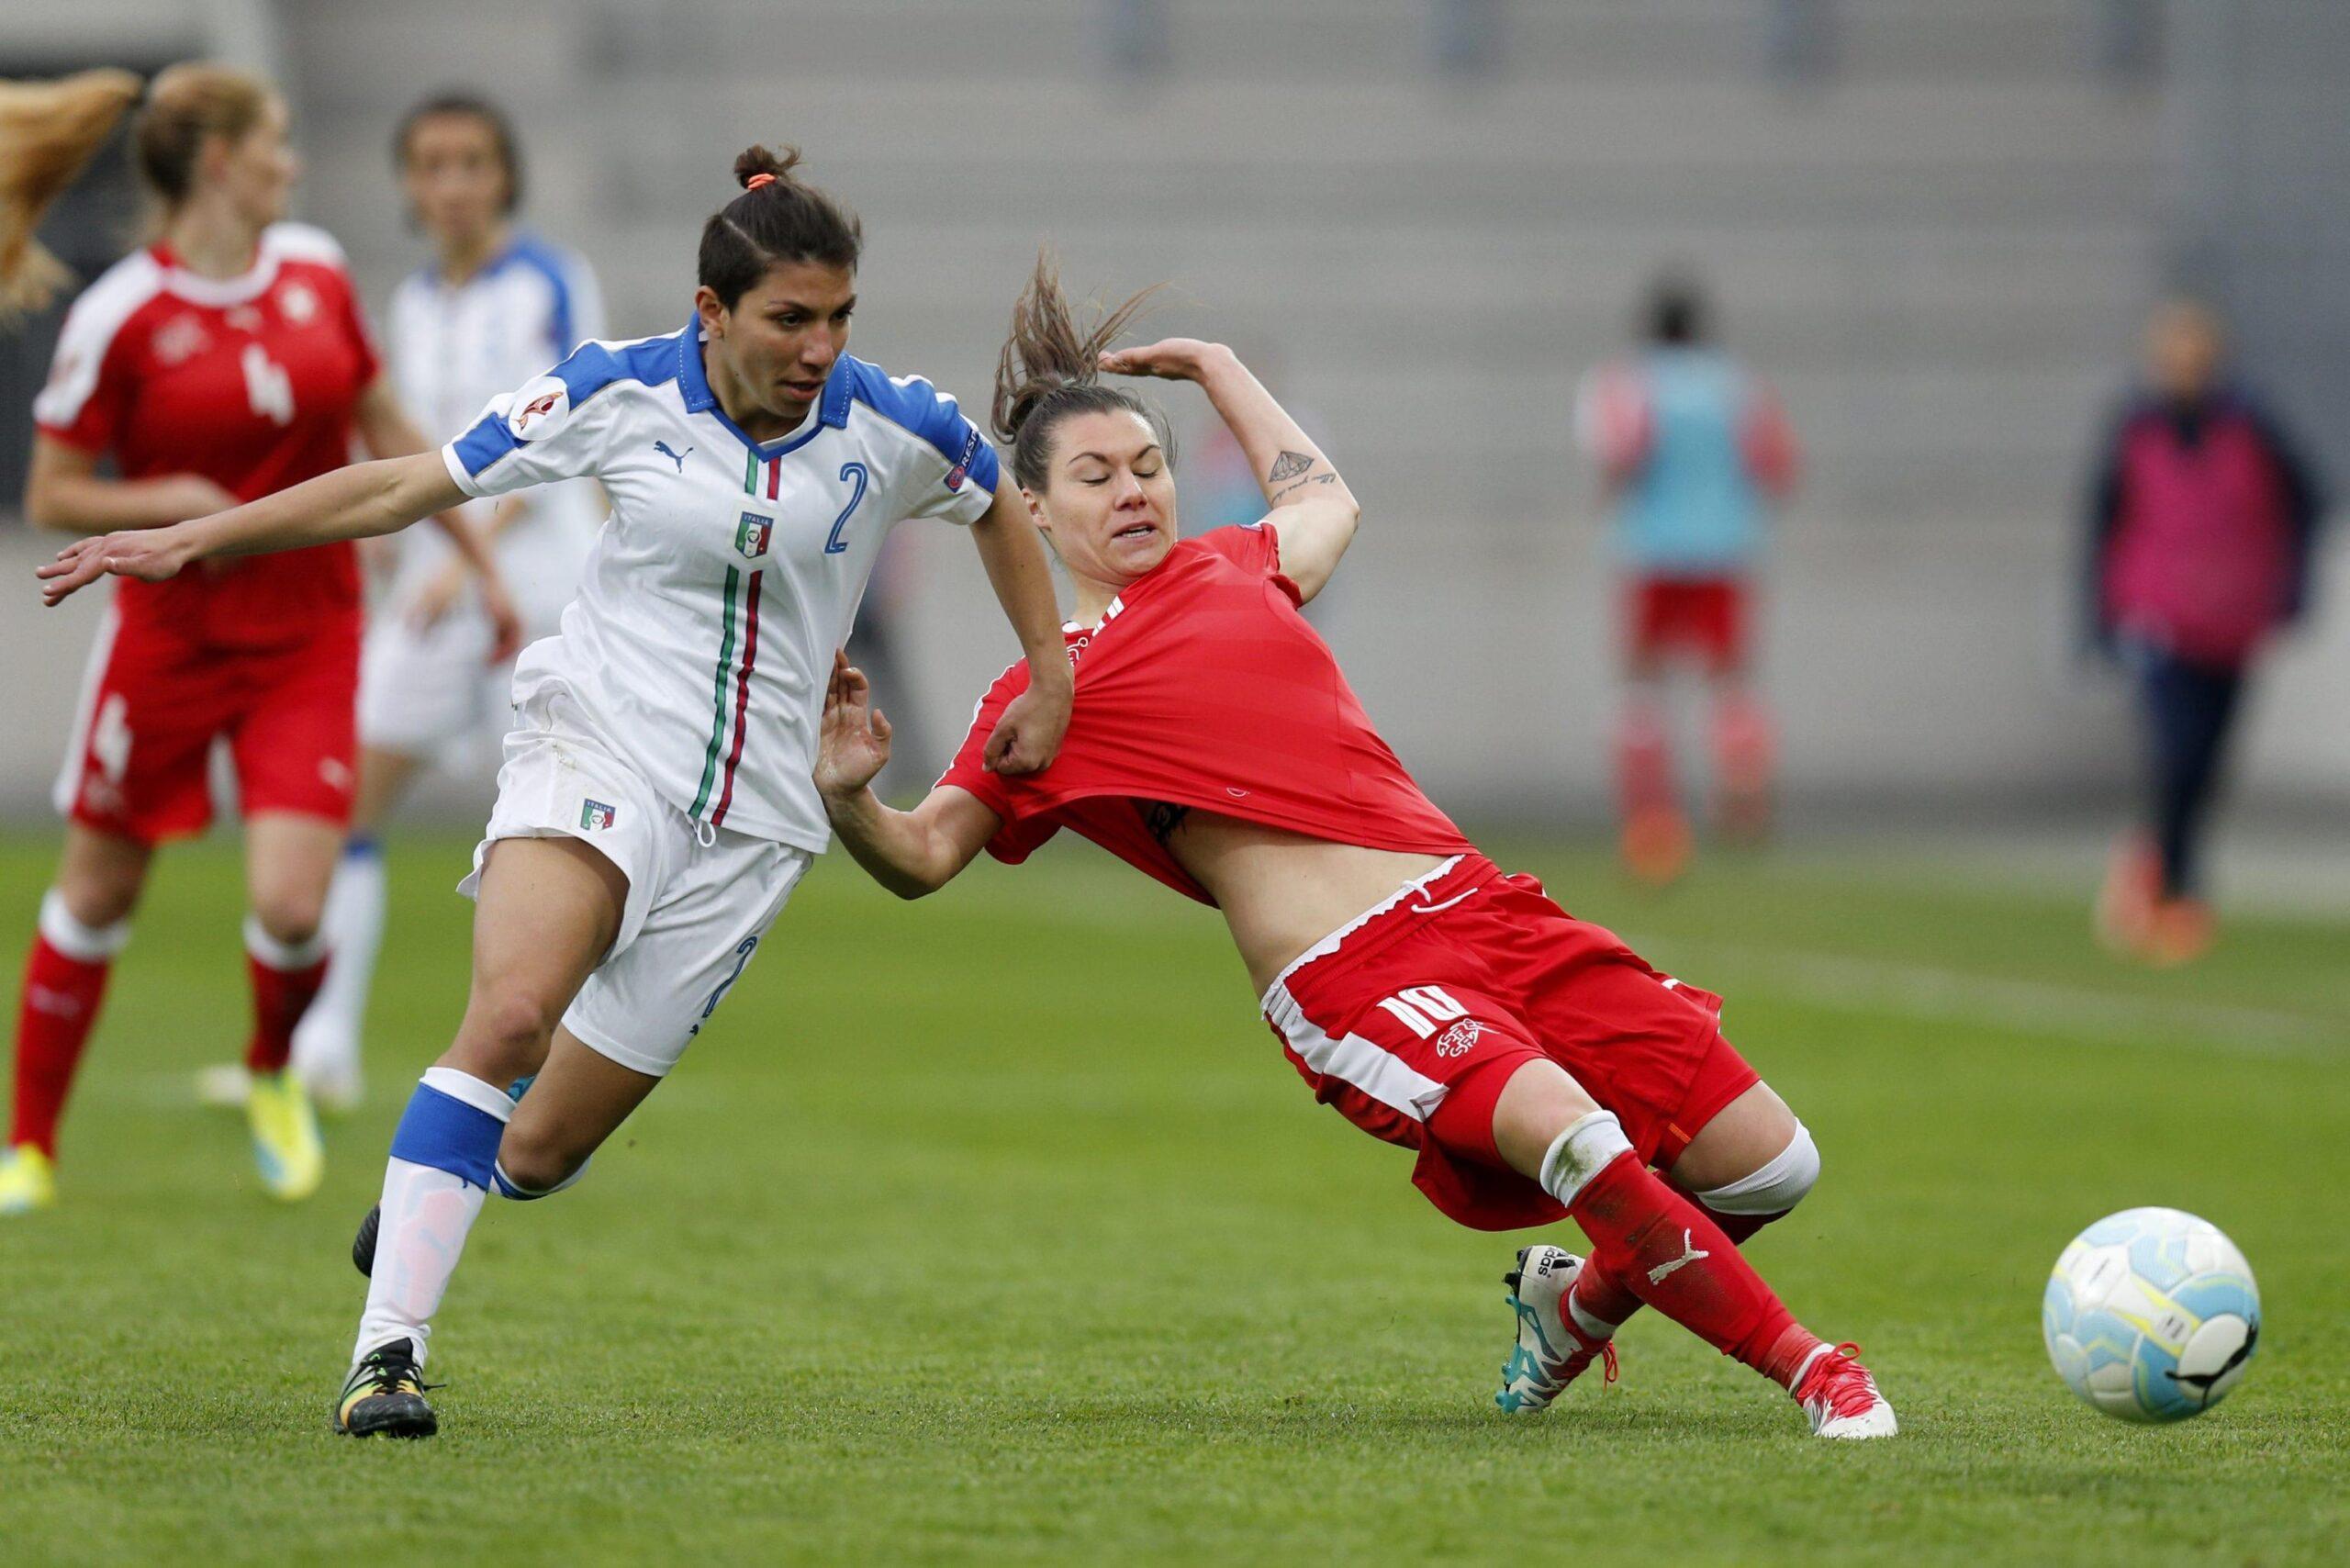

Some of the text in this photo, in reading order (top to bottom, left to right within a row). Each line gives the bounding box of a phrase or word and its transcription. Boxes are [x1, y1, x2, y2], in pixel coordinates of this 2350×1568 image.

[240, 341, 297, 428] 4
[744, 515, 769, 525] ITALIA
[824, 462, 868, 554] 2
[95, 694, 136, 785] 4
[588, 801, 611, 812] ITALIA
[701, 935, 758, 1018] 2
[1375, 984, 1471, 1040] 10
